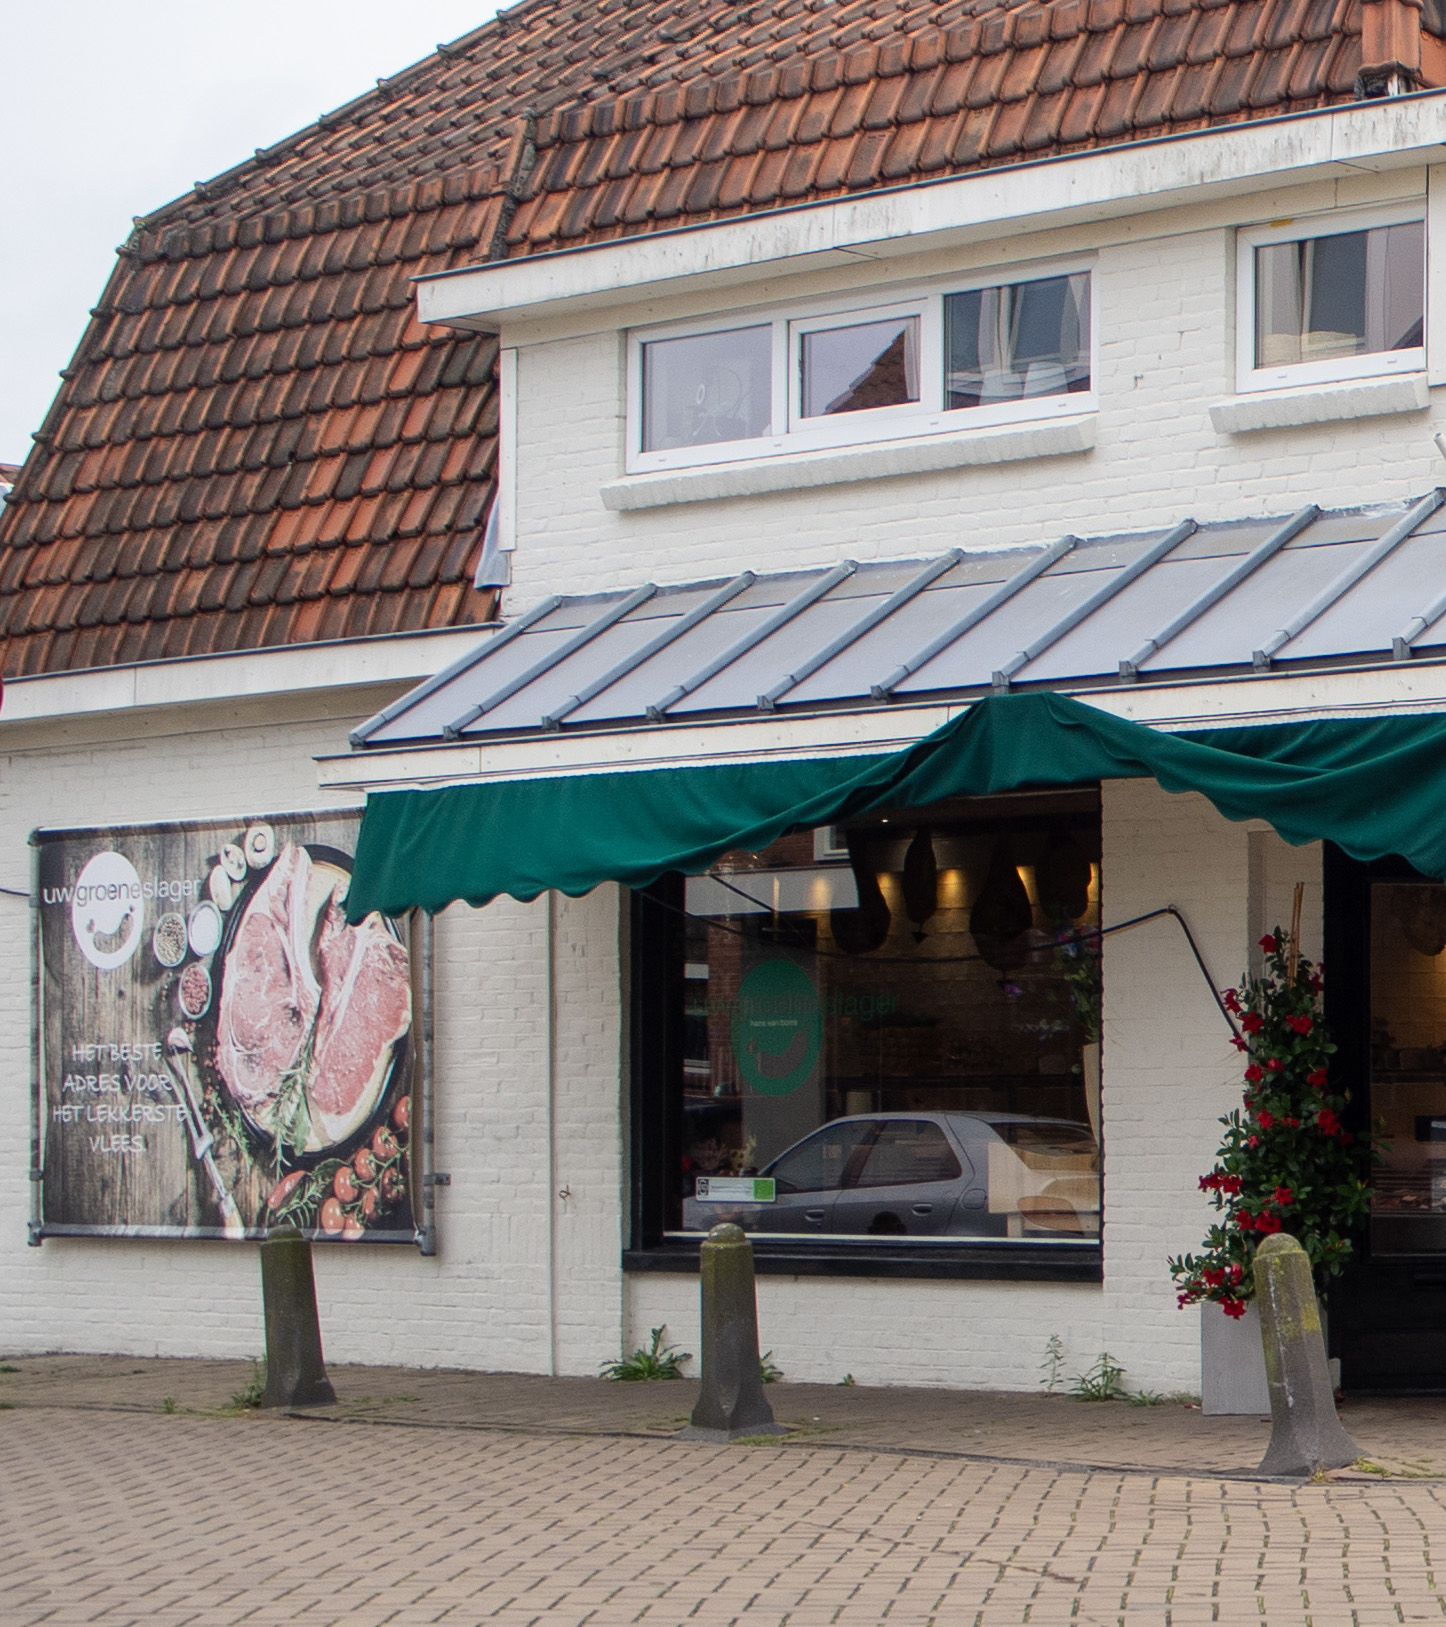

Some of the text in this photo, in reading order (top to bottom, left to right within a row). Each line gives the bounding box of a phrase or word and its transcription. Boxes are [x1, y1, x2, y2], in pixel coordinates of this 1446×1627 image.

[72, 1042, 162, 1062] HET BESTE
[62, 1073, 173, 1093] ADRES VOOR
[52, 1103, 187, 1123] HET LEKKERSTE
